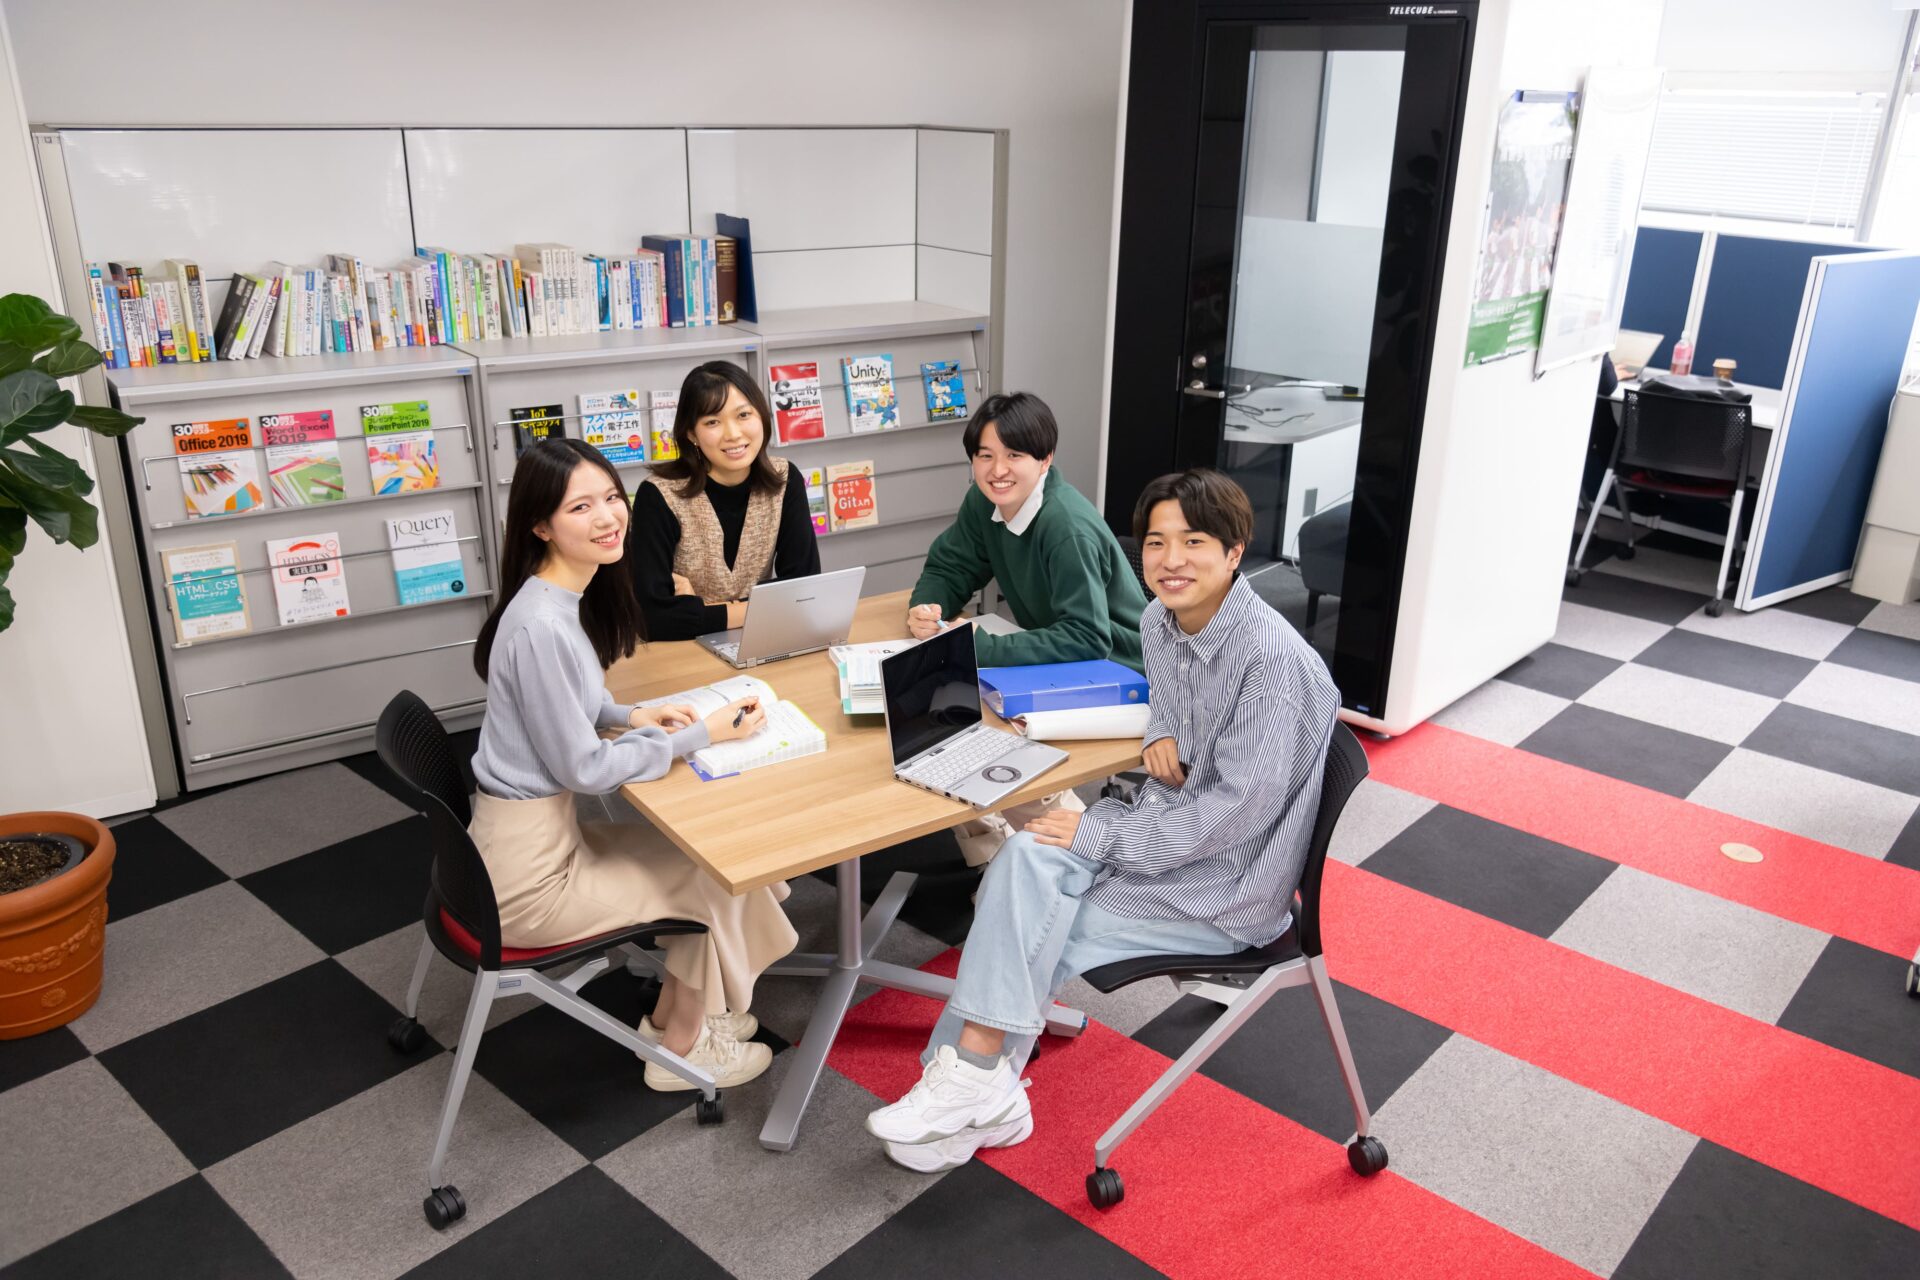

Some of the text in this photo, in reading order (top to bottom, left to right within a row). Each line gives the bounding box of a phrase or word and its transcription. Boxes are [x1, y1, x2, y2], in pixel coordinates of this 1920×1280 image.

[1390, 6, 1434, 15] TELECUBE
[363, 406, 380, 417] 30
[530, 408, 547, 419] IoT
[261, 416, 280, 428] 30
[368, 418, 430, 432] PowerPoint 2019
[607, 419, 640, 431] 電子工作
[174, 425, 193, 437] 30
[265, 423, 330, 435] Word Excel
[178, 433, 249, 452] Office 2019
[267, 432, 308, 446] 2019
[587, 433, 622, 443] 入門 ガイド
[392, 515, 452, 543] jQuery
[176, 579, 238, 597] HTML CSS
